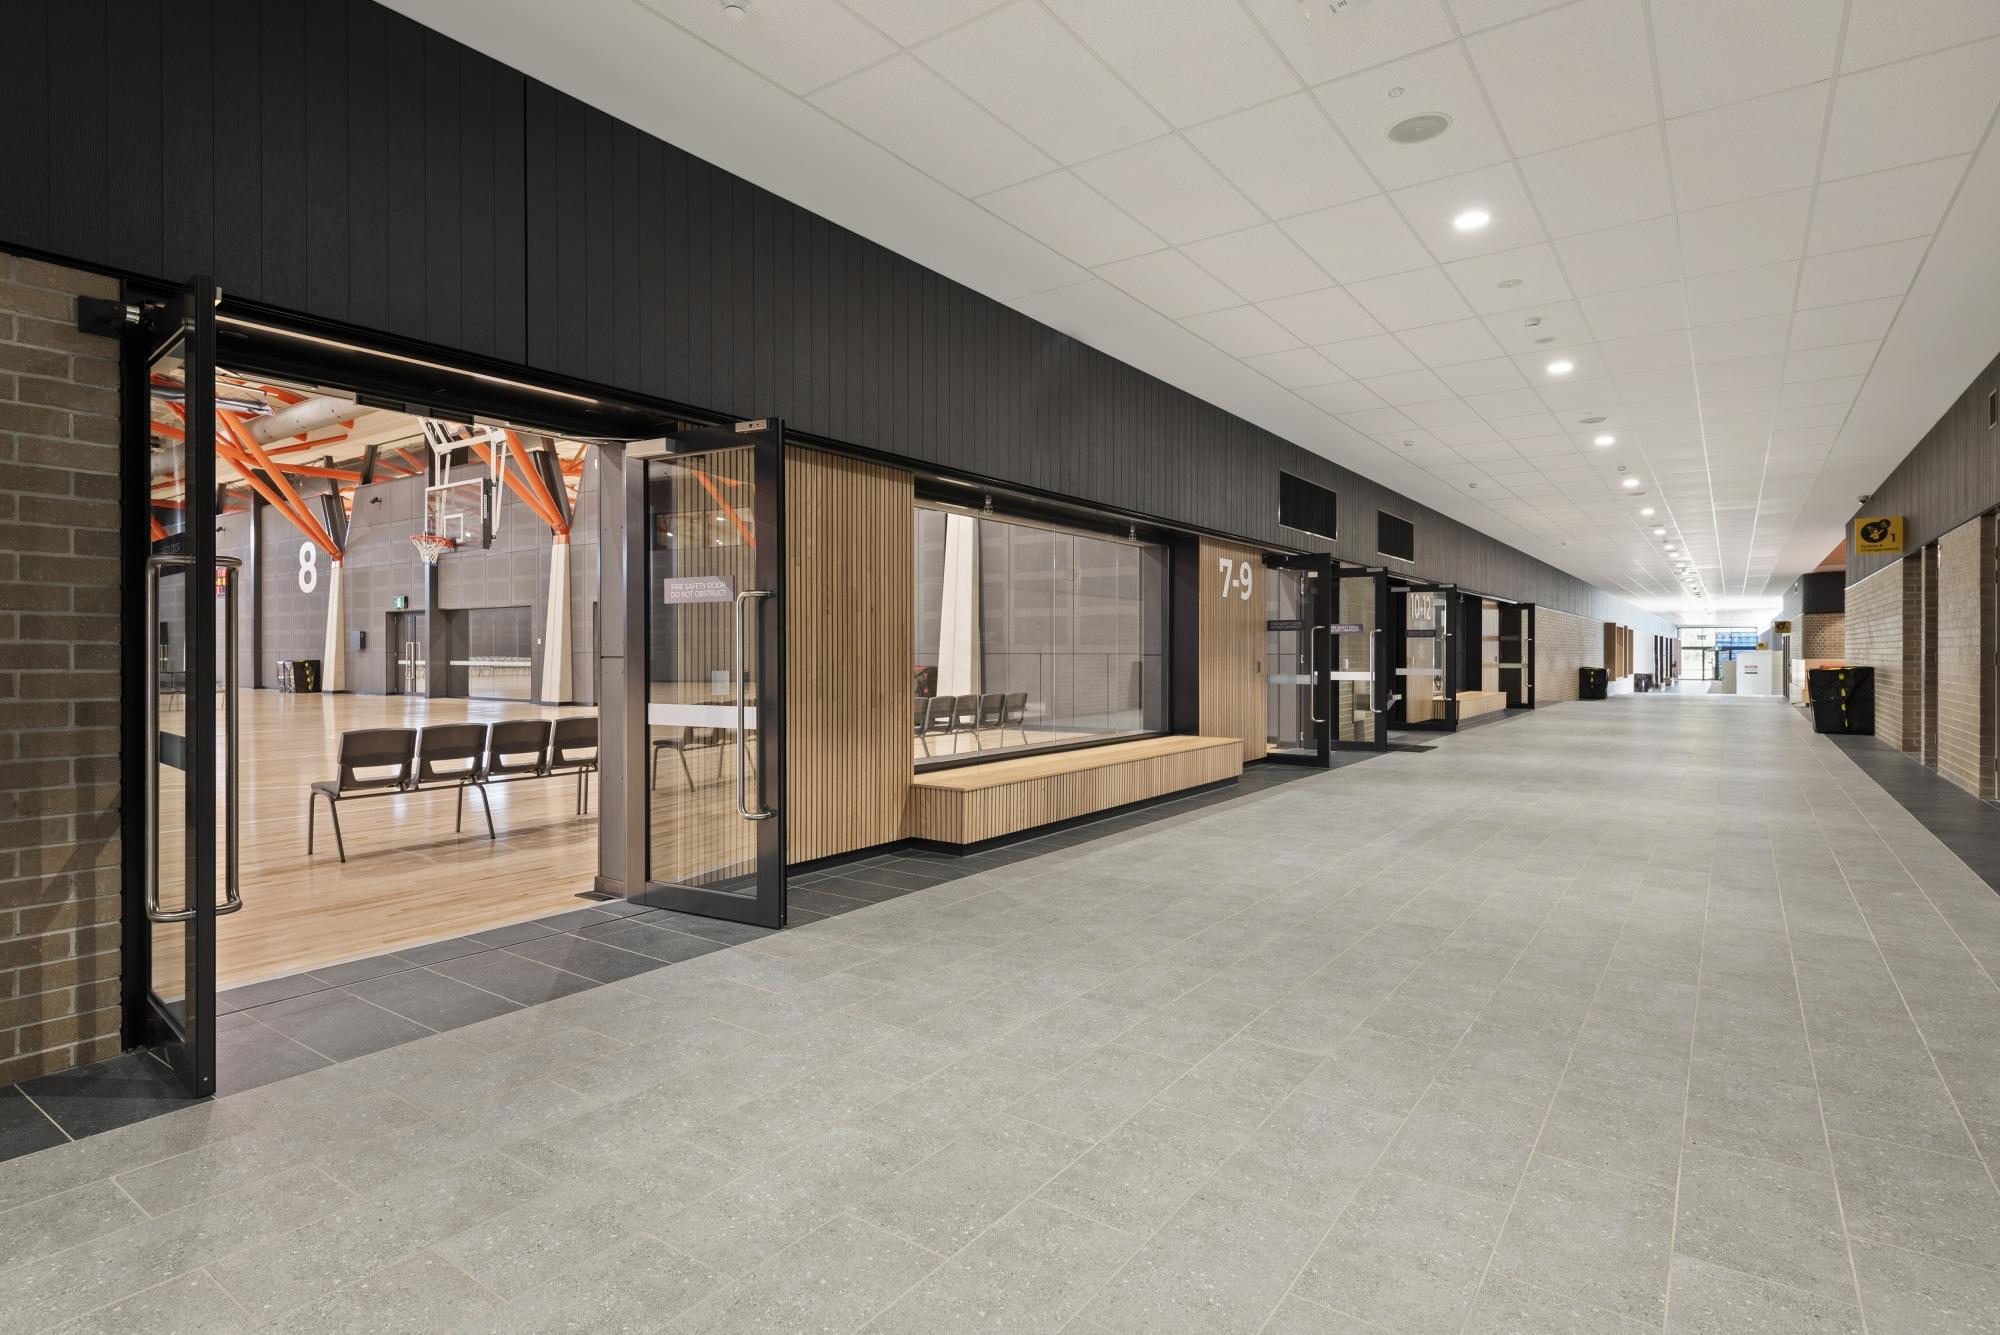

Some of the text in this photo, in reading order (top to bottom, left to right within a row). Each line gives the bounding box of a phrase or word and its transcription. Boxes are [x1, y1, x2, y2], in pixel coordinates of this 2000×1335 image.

[1889, 533, 1895, 543] 1
[298, 541, 317, 594] 8
[707, 581, 726, 589] DOOR
[1219, 557, 1252, 600] 7-9
[670, 591, 680, 599] DO
[1410, 593, 1431, 619] 10-12
